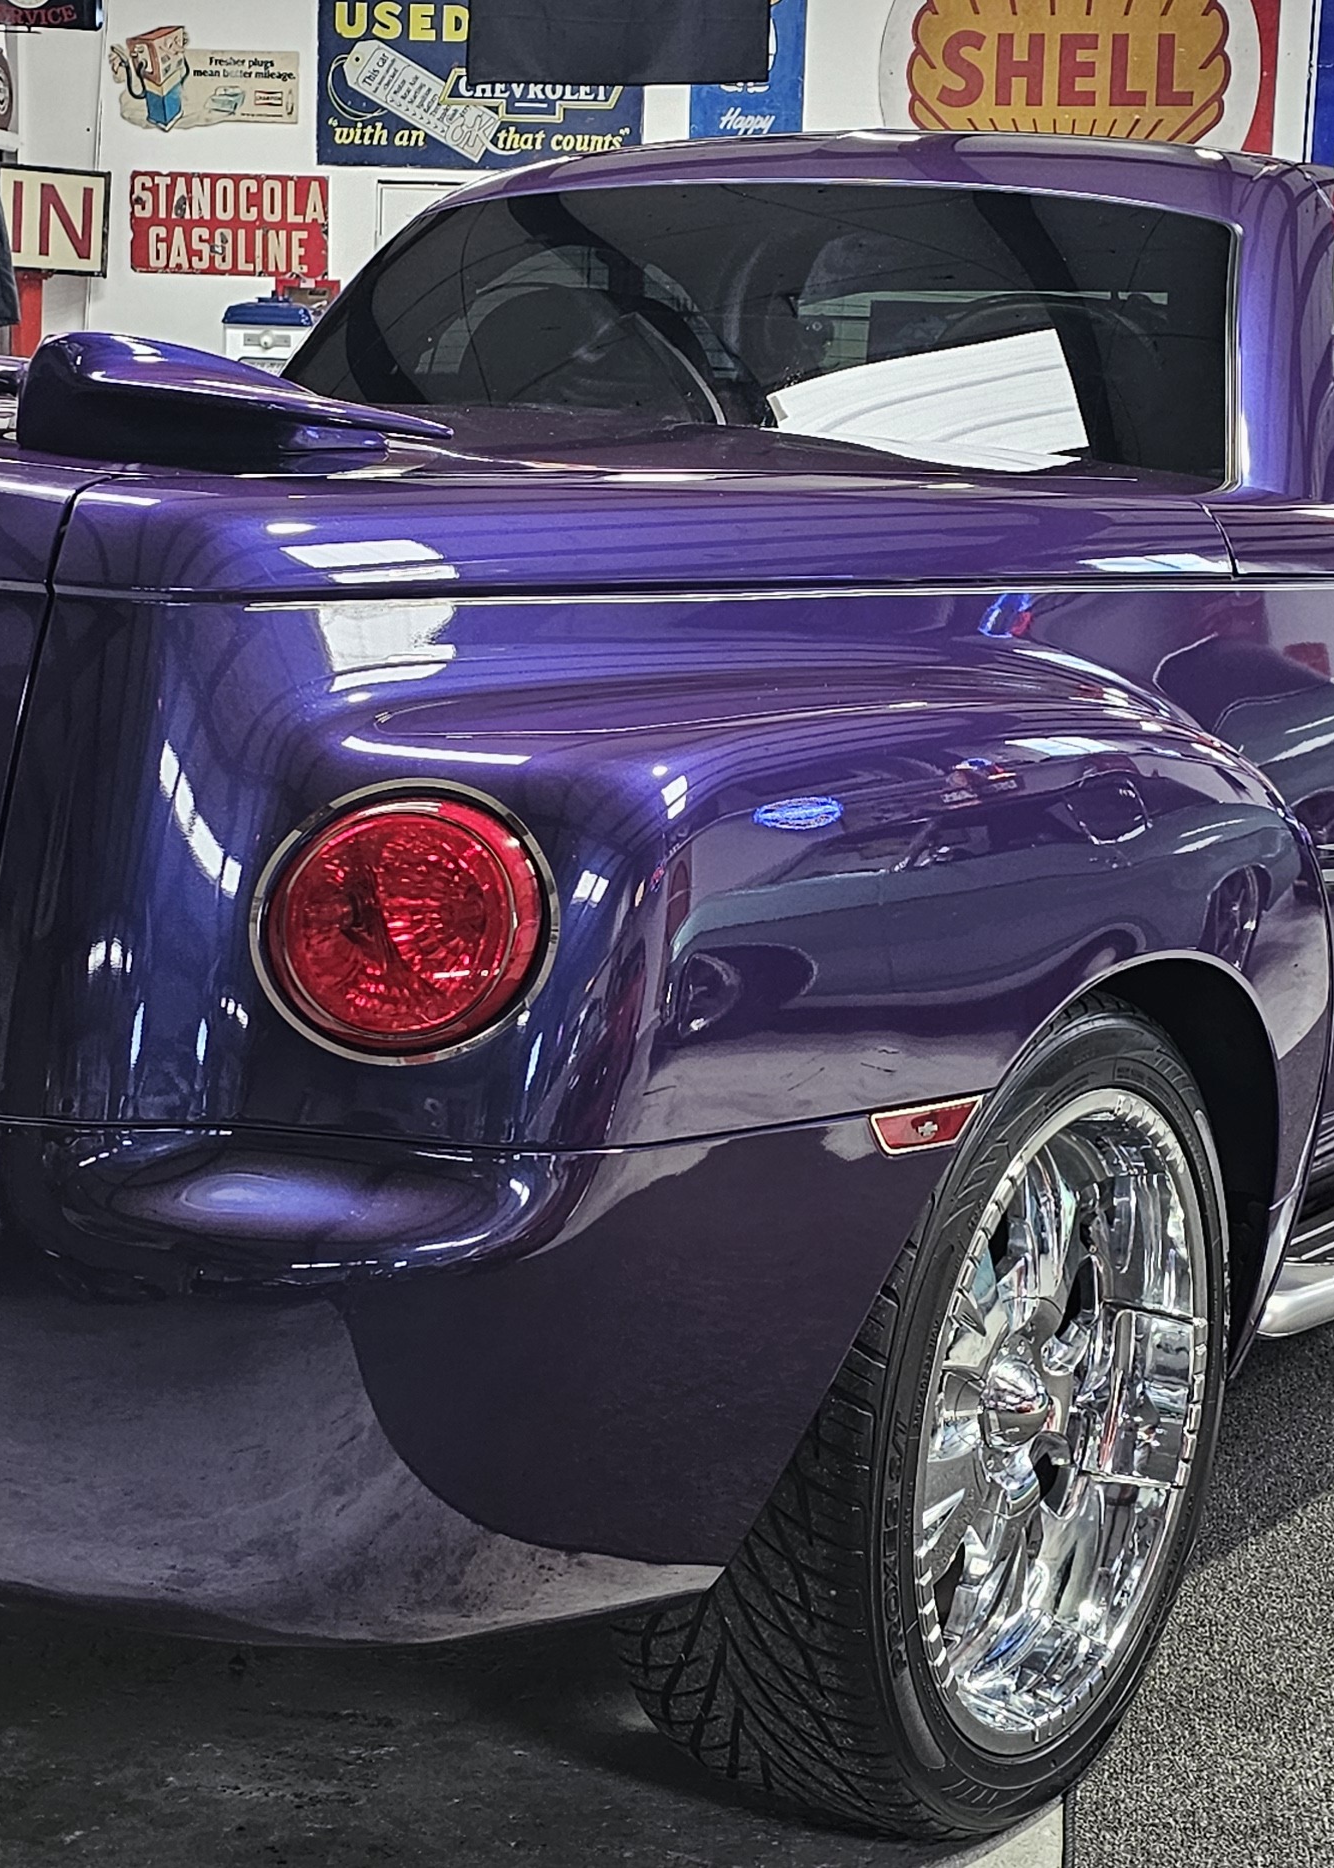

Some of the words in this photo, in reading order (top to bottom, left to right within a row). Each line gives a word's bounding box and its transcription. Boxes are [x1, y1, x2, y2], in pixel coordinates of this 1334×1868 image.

[335, 1, 469, 42] USED
[193, 69, 220, 77] mean
[254, 70, 296, 82] mileage.
[208, 56, 246, 67] Fresher
[248, 58, 275, 70] plugs
[936, 29, 1194, 107] SHELL
[394, 129, 425, 147] an
[496, 127, 543, 151] that
[719, 106, 776, 135] Happy
[133, 175, 325, 223] STANOCOLA
[12, 180, 93, 260] IN
[148, 225, 308, 273] GASOLINE
